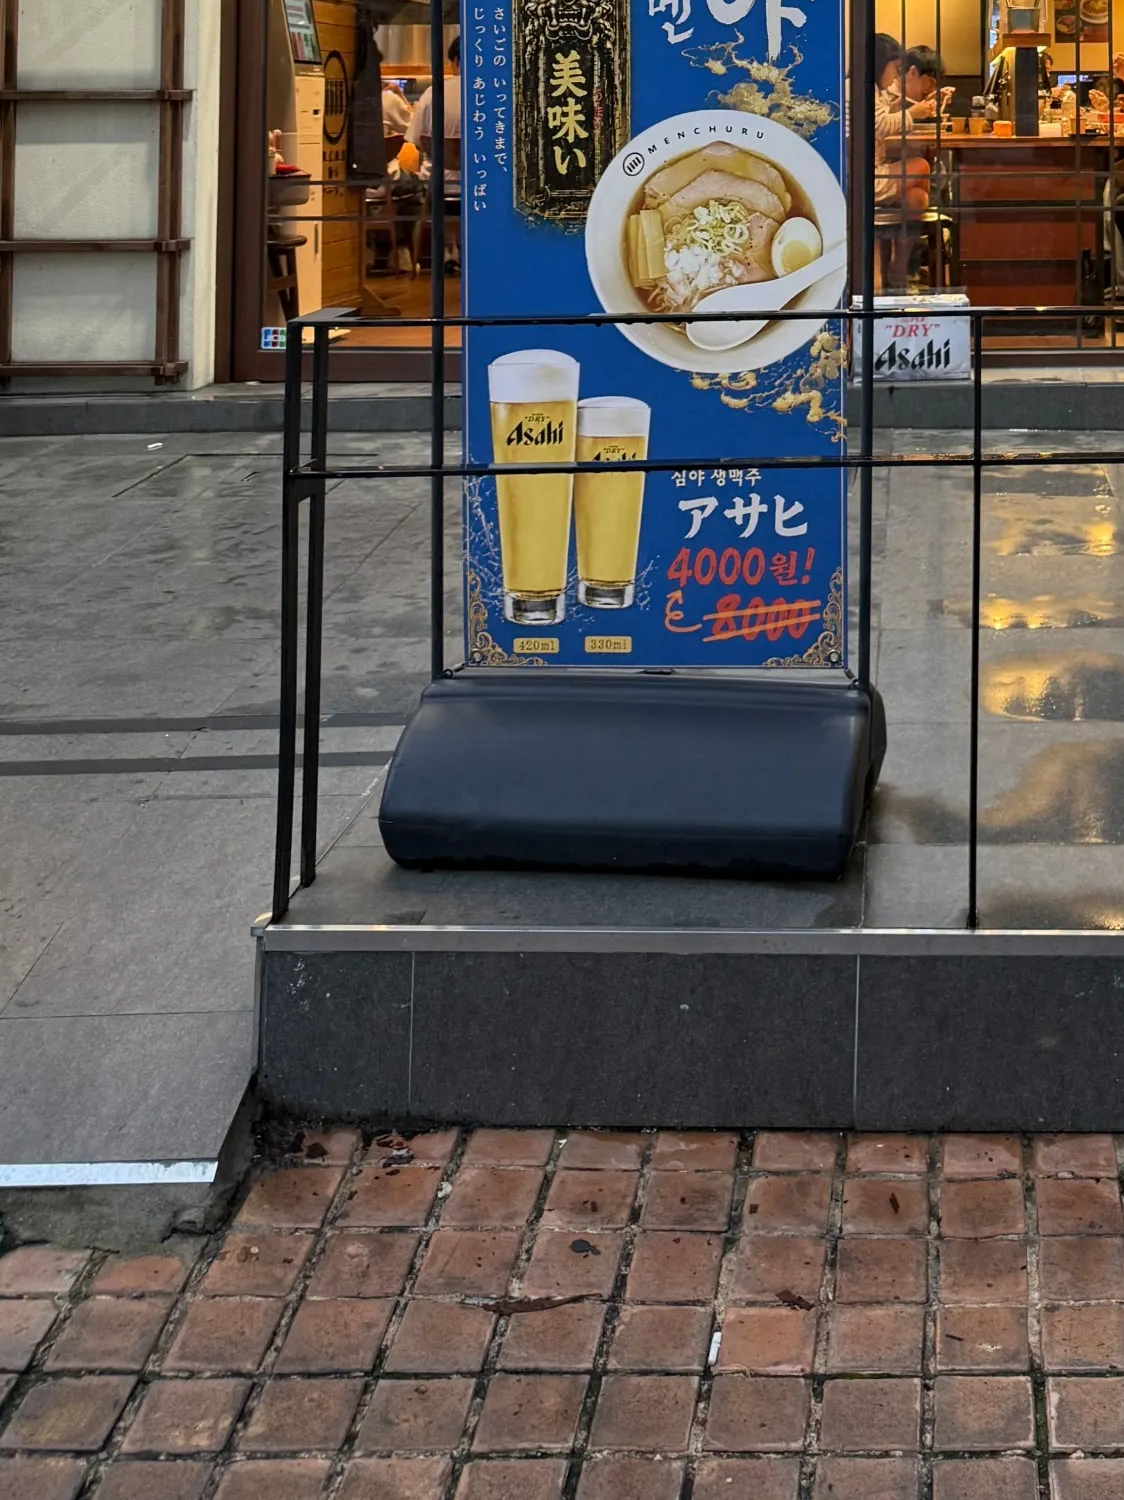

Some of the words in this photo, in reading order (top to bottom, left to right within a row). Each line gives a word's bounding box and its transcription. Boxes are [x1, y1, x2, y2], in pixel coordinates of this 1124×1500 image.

[473, 7, 486, 67] じっくり
[493, 7, 507, 67] さいごの
[473, 77, 486, 140] あじわう
[547, 49, 588, 176] 美味い
[647, 125, 764, 154] MENCHURU
[874, 338, 950, 371] Asahi
[506, 420, 564, 446] Asahi
[671, 469, 705, 486] 심야
[711, 468, 762, 487] 생맥주
[678, 493, 808, 538] アサヒ
[667, 547, 816, 587] 4000원!
[712, 593, 812, 641] 8000
[518, 640, 555, 651] 420ml
[590, 639, 627, 650] 330ml
